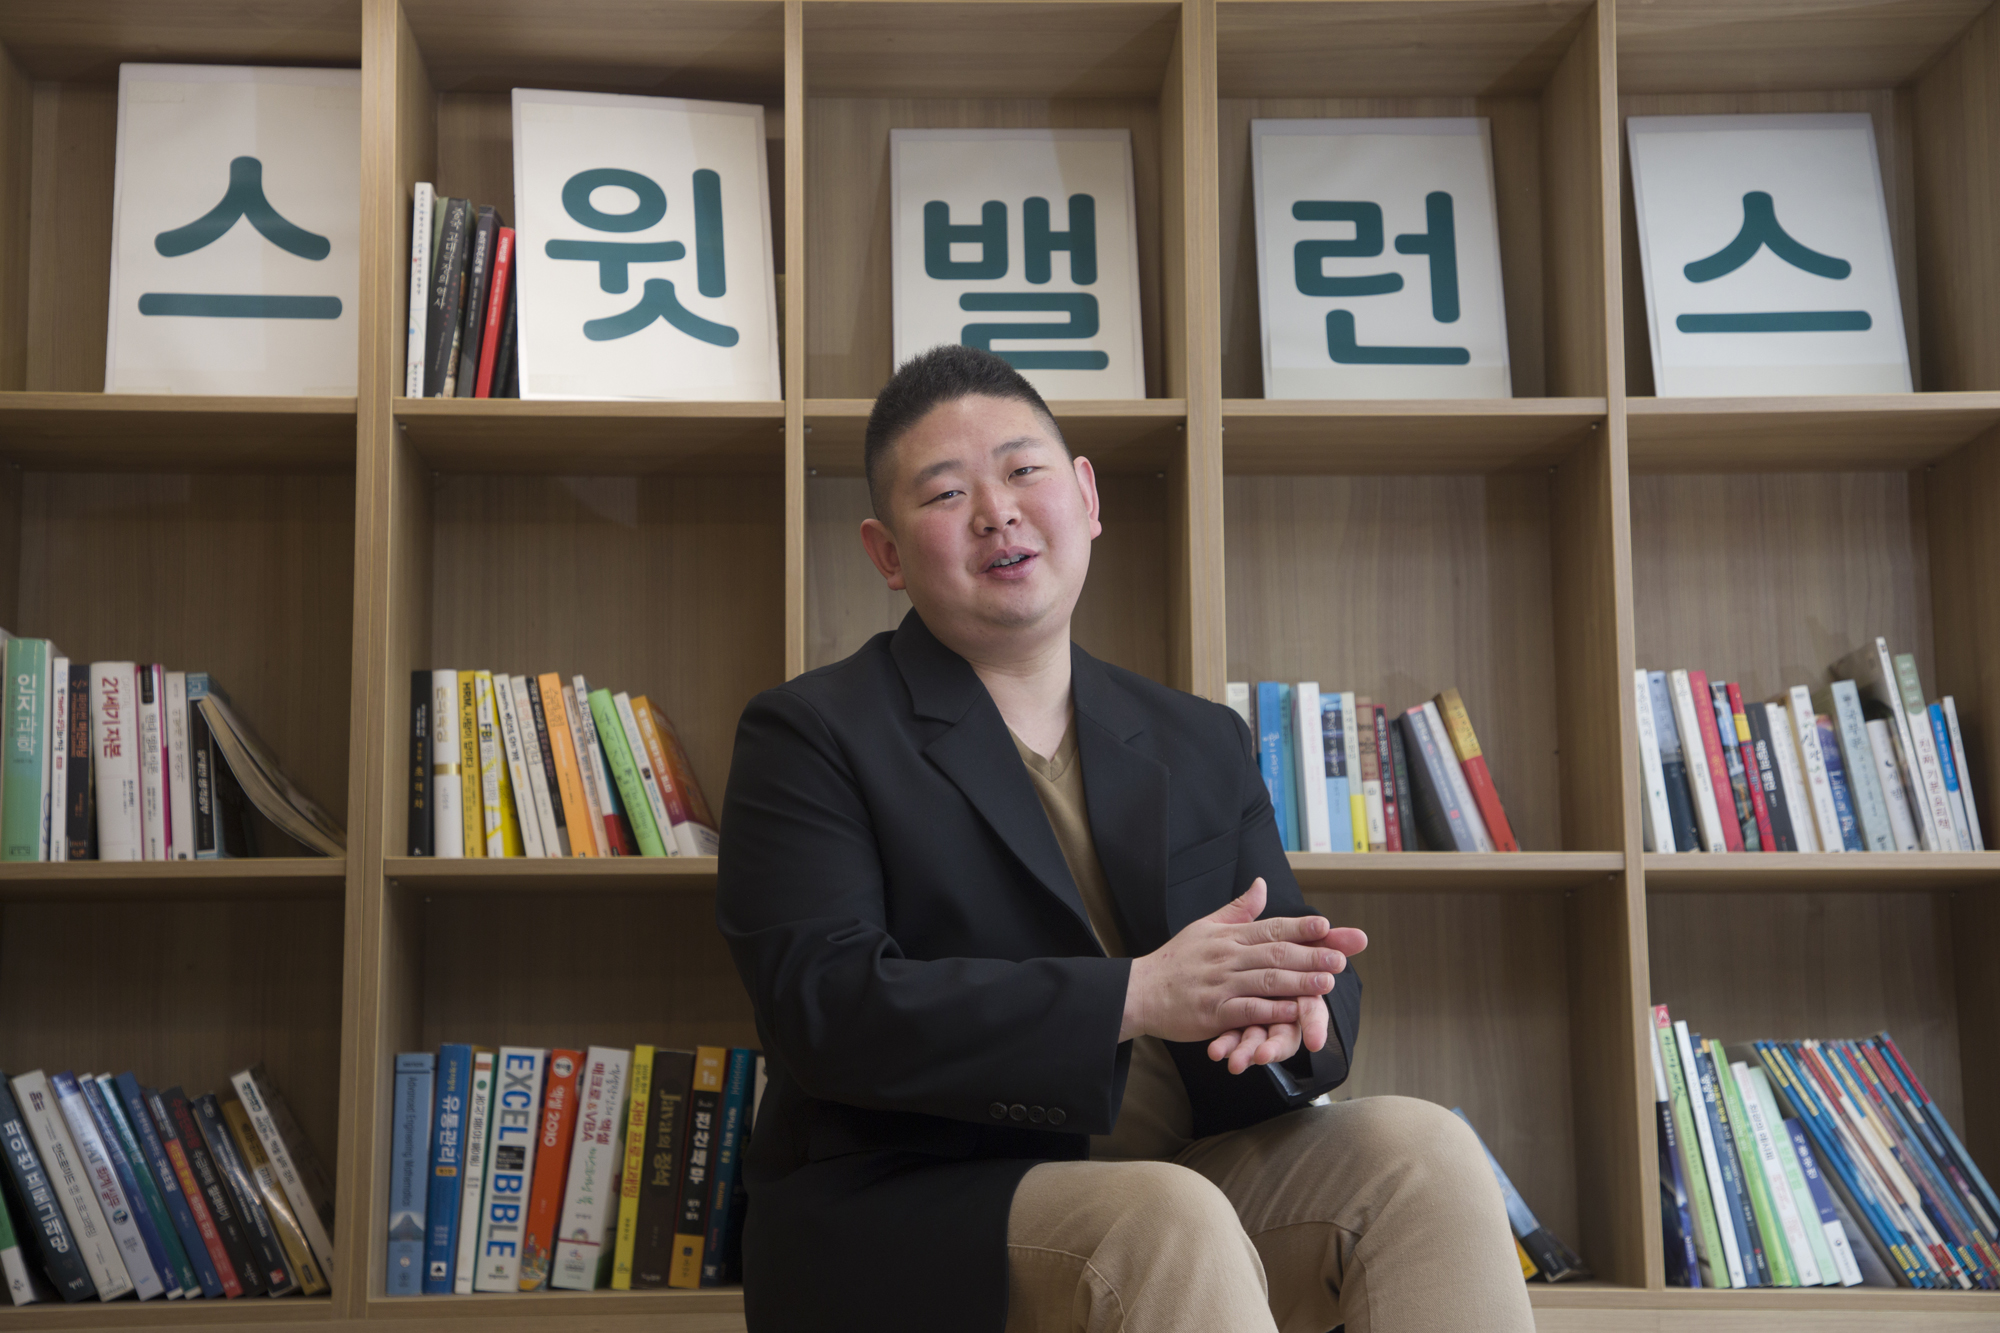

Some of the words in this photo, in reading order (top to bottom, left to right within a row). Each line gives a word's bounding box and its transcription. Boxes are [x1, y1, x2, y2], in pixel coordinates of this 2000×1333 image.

[137, 155, 343, 319] 스
[544, 167, 740, 347] 윗
[922, 192, 1110, 371] 밸
[1291, 191, 1471, 367] 런
[1675, 190, 1872, 333] 스
[17, 673, 37, 756] 인지과학
[101, 676, 121, 727] 21세기
[103, 728, 122, 760] 자본
[481, 722, 493, 743] FBI
[406, 1076, 418, 1113] Advanced
[499, 1053, 535, 1141] EXCEL
[630, 1099, 646, 1127] 자바
[656, 1088, 682, 1149] Java의
[402, 1114, 416, 1159] Engineering
[438, 1094, 461, 1165] 유통관리
[543, 1111, 561, 1147] 2010
[596, 1117, 613, 1146] 엑셀
[3, 1118, 37, 1169] 파이썬
[23, 1170, 69, 1254] 프로그래밍
[401, 1159, 413, 1207] Mathematics
[622, 1131, 643, 1199] 프로그래밍
[652, 1151, 673, 1187] 정석
[486, 1173, 524, 1258] BIBLE
